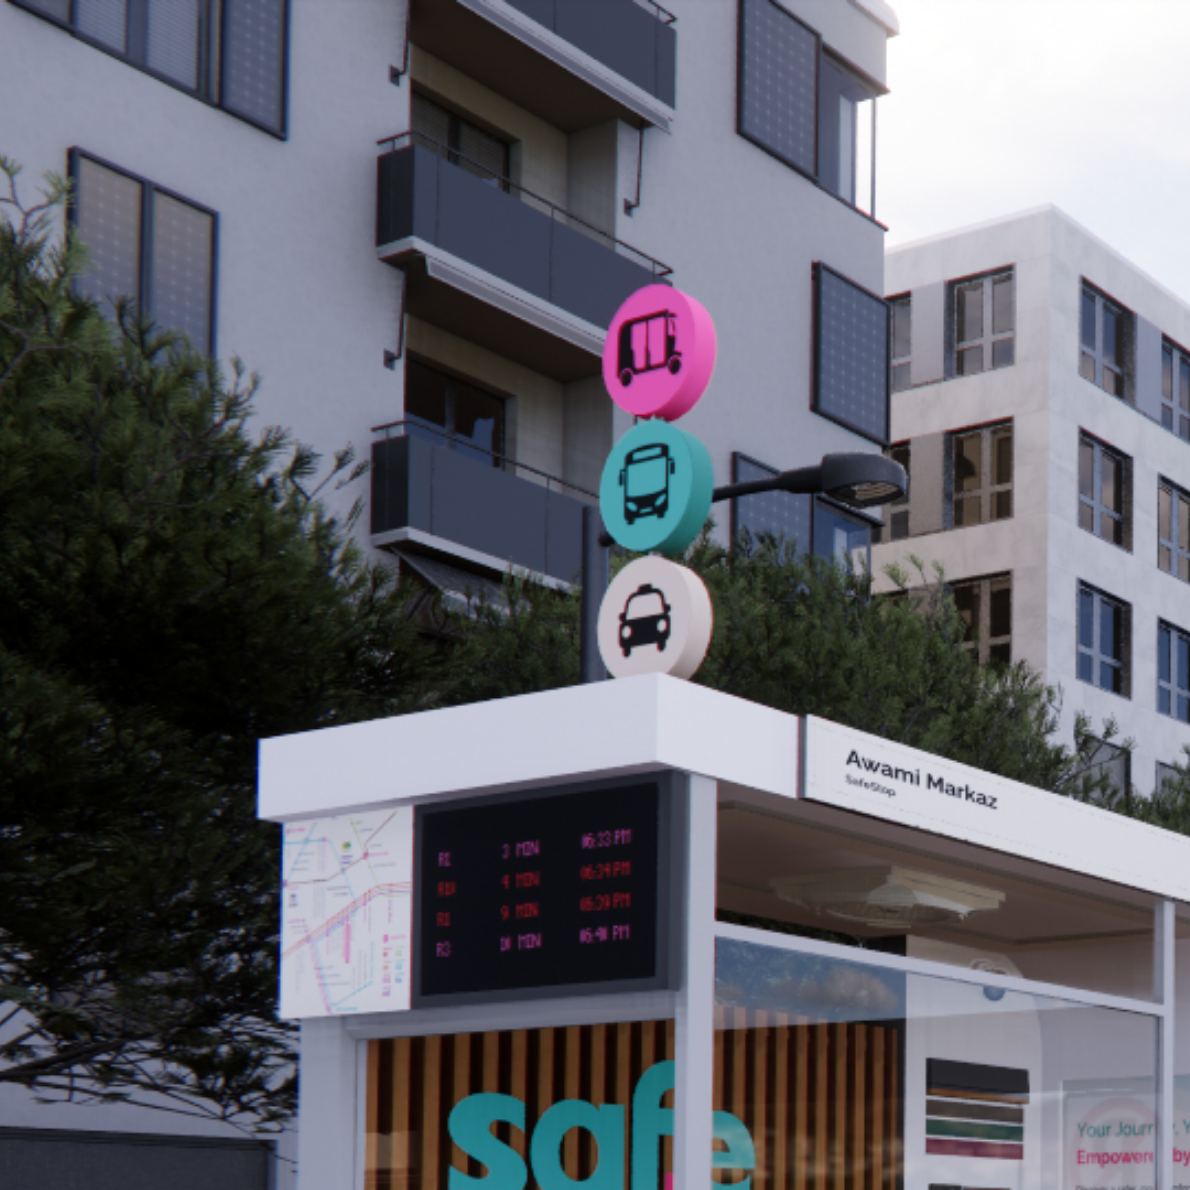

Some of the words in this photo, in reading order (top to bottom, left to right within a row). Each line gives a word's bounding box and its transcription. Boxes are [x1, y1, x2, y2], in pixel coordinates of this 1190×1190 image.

[845, 773, 897, 798] SafeStop
[846, 749, 920, 788] Awami
[926, 772, 998, 809] Markaz
[516, 841, 539, 856] MIN
[614, 829, 632, 844] PM
[501, 874, 510, 889] 4
[516, 872, 539, 887] MIN
[613, 861, 630, 876] PM
[501, 905, 510, 920] 9
[516, 903, 538, 918] MIN
[613, 893, 630, 907] PM
[518, 934, 541, 949] MIN
[612, 924, 630, 940] PM
[1077, 1121, 1111, 1138] Your
[1077, 1149, 1154, 1168] Empower
